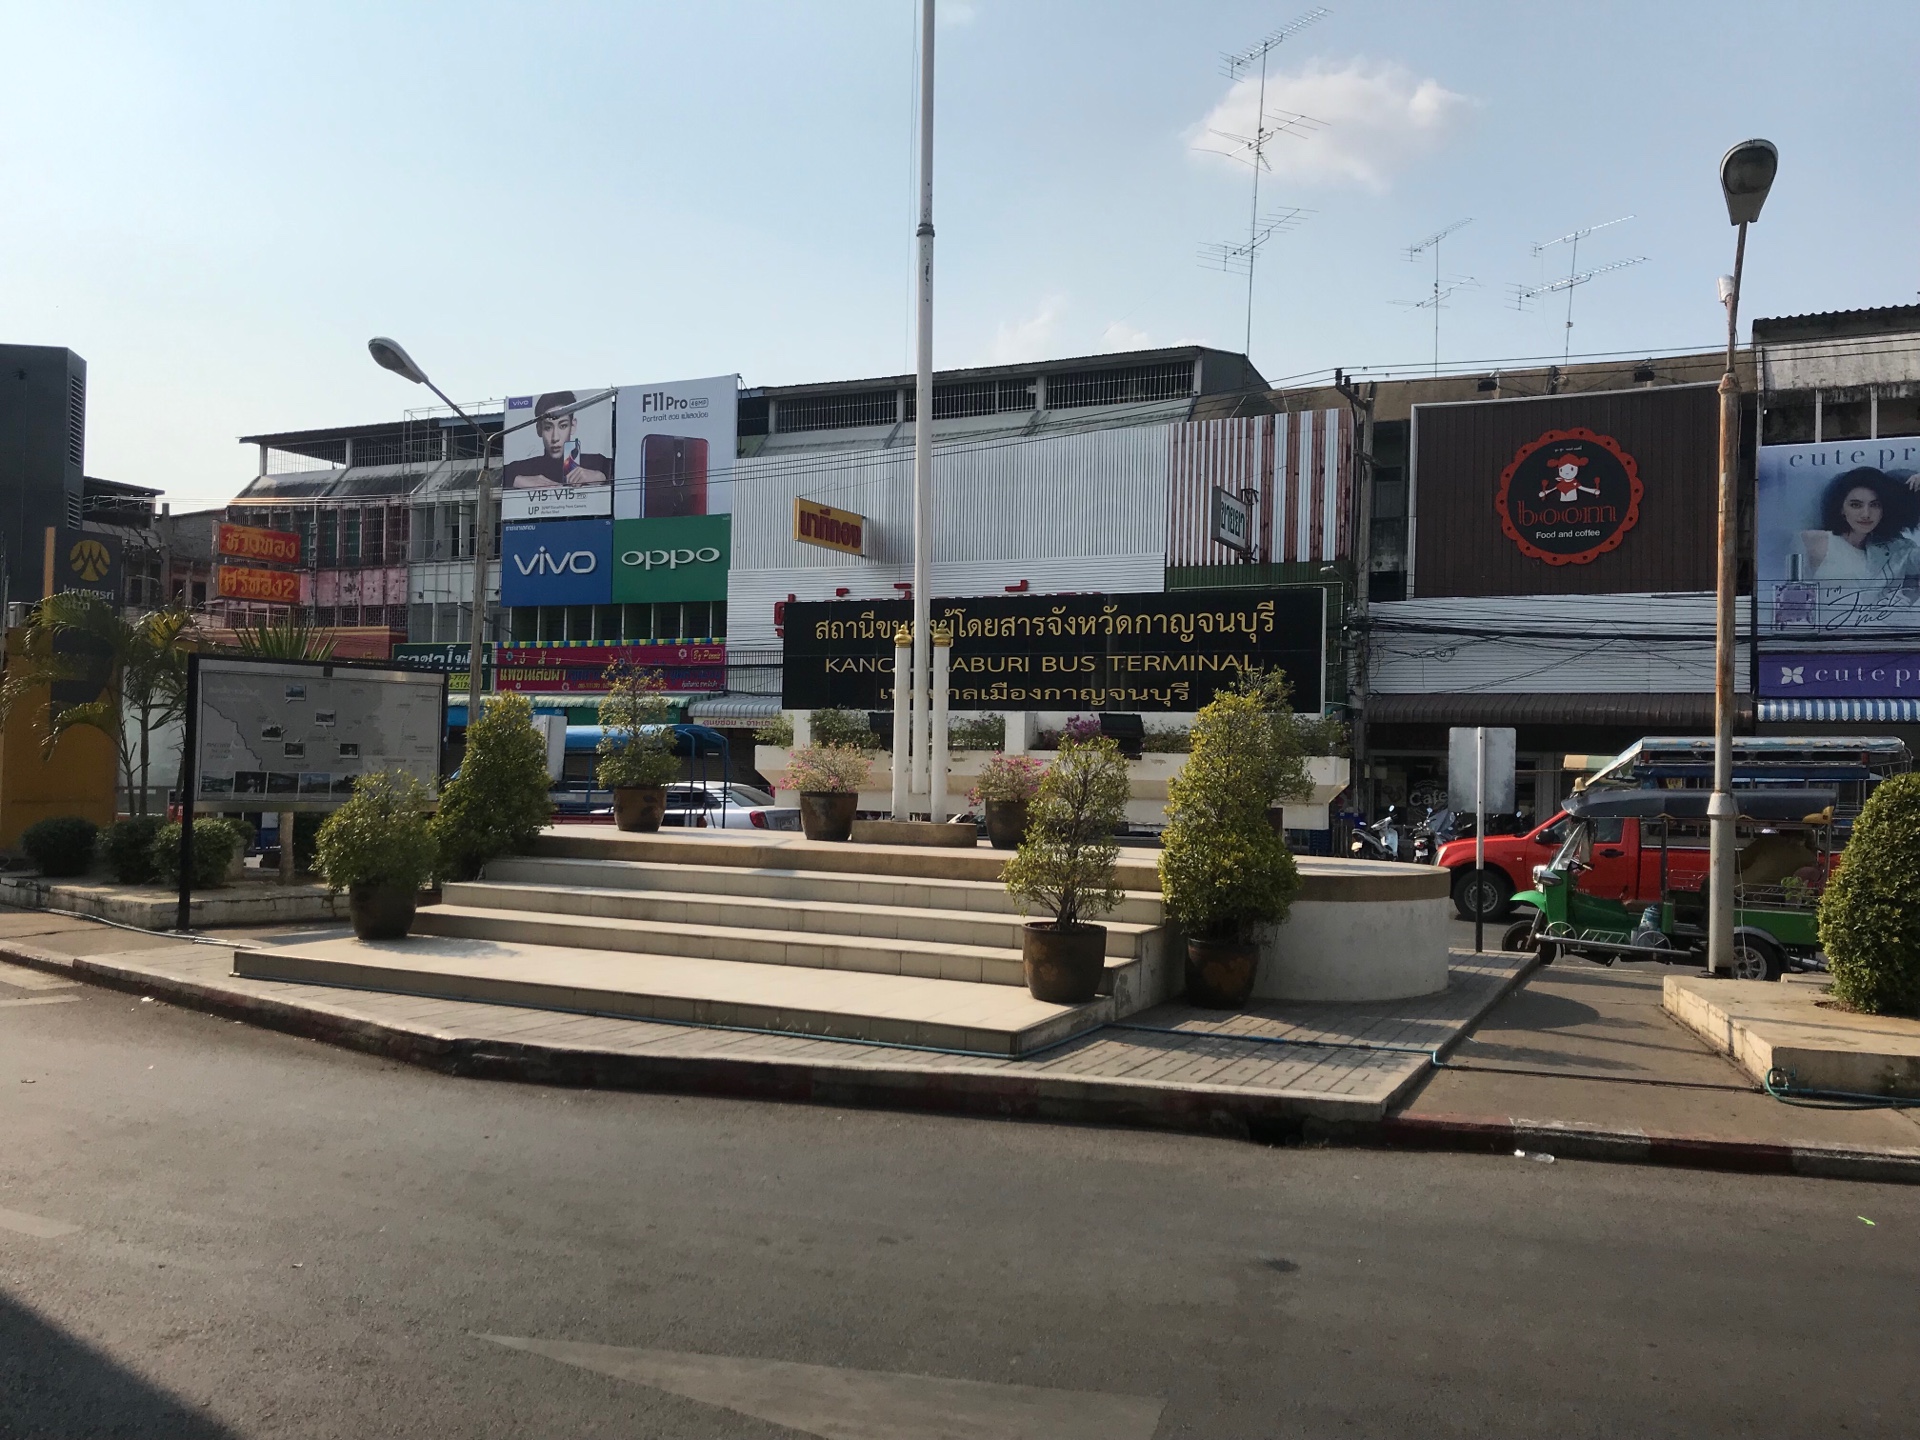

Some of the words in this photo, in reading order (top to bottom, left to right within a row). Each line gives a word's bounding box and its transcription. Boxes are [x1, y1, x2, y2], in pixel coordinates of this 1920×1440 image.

[642, 392, 664, 413] F11
[666, 396, 688, 410] Pro
[642, 413, 668, 423] Portrait
[1789, 448, 1866, 468] cute
[554, 488, 576, 501] V15
[1221, 501, 1246, 540] ขายยา
[1518, 500, 1616, 527] boom
[800, 508, 862, 549] นาทีทอง
[1536, 531, 1556, 539] Food
[1558, 530, 1573, 538] and
[1575, 529, 1600, 537] coffee
[514, 545, 596, 576] vivo
[815, 600, 1275, 647] สถานีขนงผู้โดยสารจังหวัดกาญจนบุรี
[825, 655, 1029, 674] KANCABURI
[1042, 655, 1096, 673] BUS
[1107, 654, 1260, 673] TERMINAL
[1815, 666, 1886, 682] cute
[880, 682, 1190, 707] เาลเมืองกาญจนบุรี
